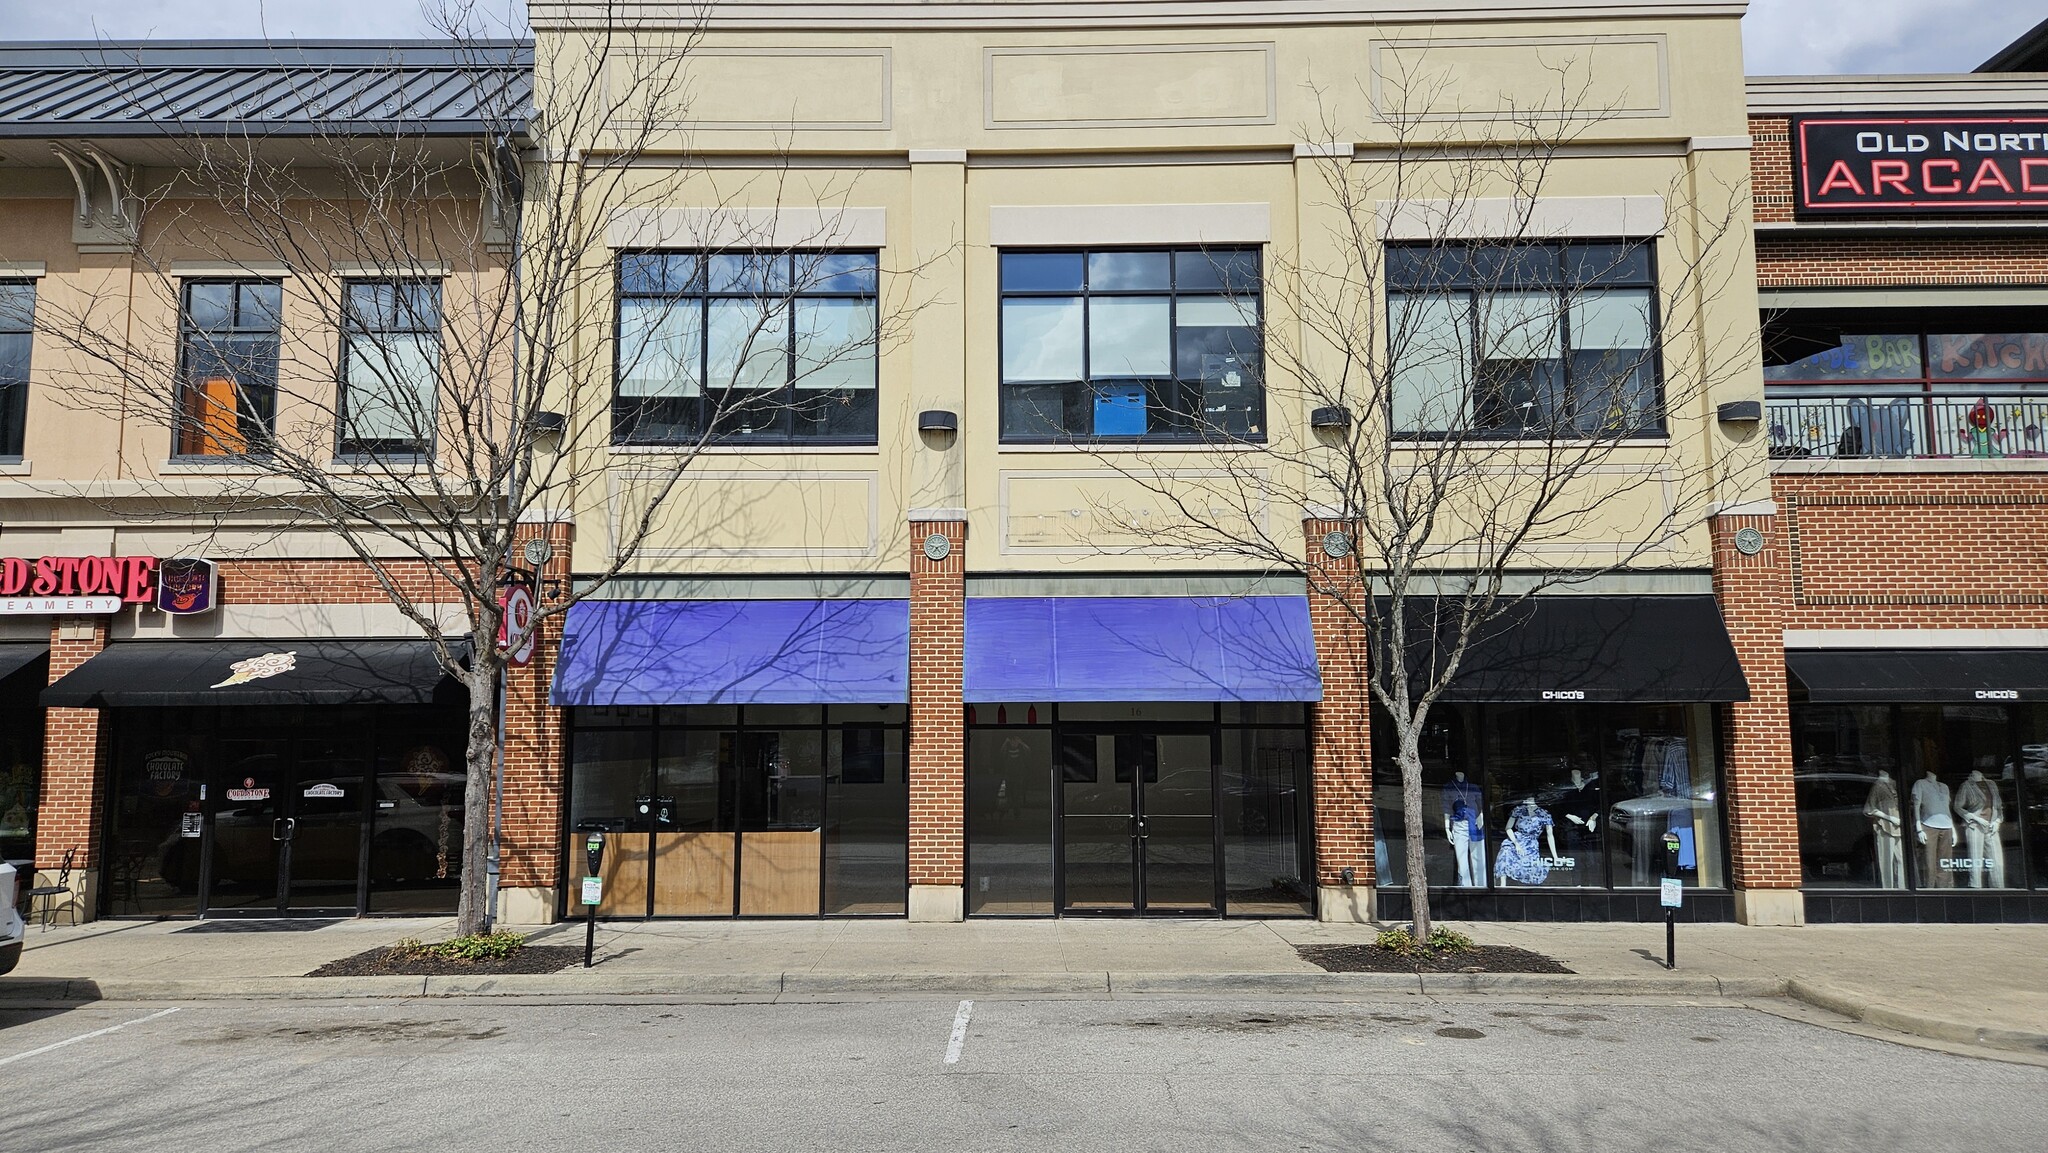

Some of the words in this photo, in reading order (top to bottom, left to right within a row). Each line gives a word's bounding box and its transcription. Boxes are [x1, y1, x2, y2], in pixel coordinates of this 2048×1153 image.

[1856, 131, 1930, 153] OLD
[1943, 131, 2048, 151] NORT
[1866, 334, 1921, 370] BAR
[1941, 333, 2048, 373] KiTCH
[32, 555, 154, 602] STONE
[1542, 690, 1585, 699] CHICO'S
[1975, 689, 2018, 699] CHICO'S
[1131, 707, 1142, 716] 16
[146, 761, 185, 772] CHOCOLATE
[150, 770, 181, 781] FACTORY
[1940, 857, 1994, 868] CHICO'S
